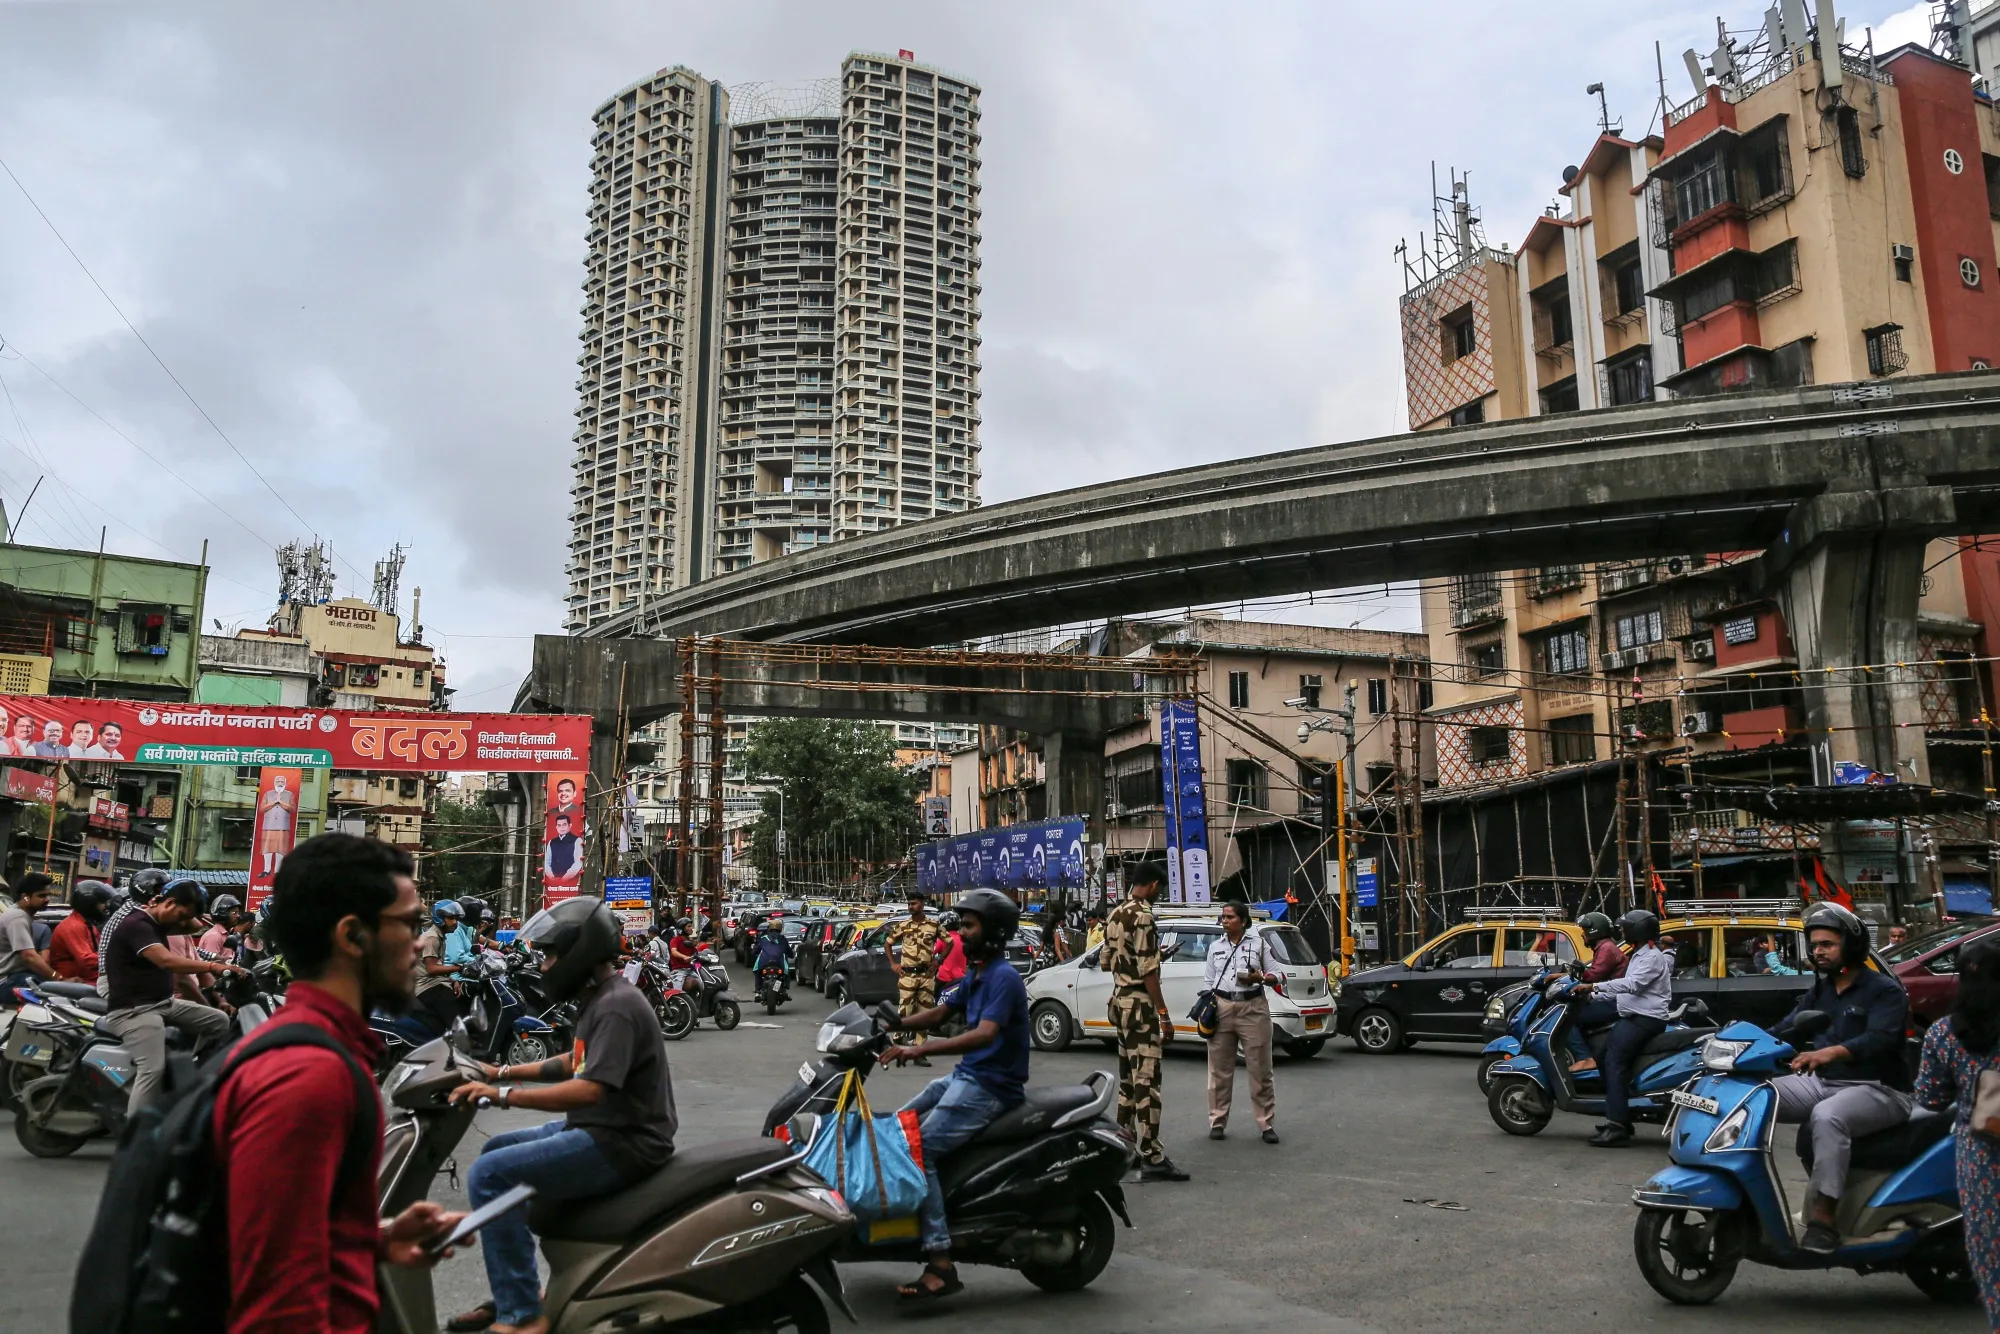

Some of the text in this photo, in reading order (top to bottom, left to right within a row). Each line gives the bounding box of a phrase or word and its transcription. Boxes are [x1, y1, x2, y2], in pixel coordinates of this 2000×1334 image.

[325, 605, 378, 622] मराठा
[161, 709, 317, 730] भारतीय जनता पार्टी
[350, 718, 472, 762] बदल
[478, 732, 556, 745] शिवडीच्या हितासाठी
[144, 747, 164, 760] सर्व
[165, 747, 197, 761] गणेश
[200, 748, 238, 763] भक्तांचे
[241, 749, 276, 764] हार्दिक
[477, 747, 532, 760] शिवडीकरांच्या
